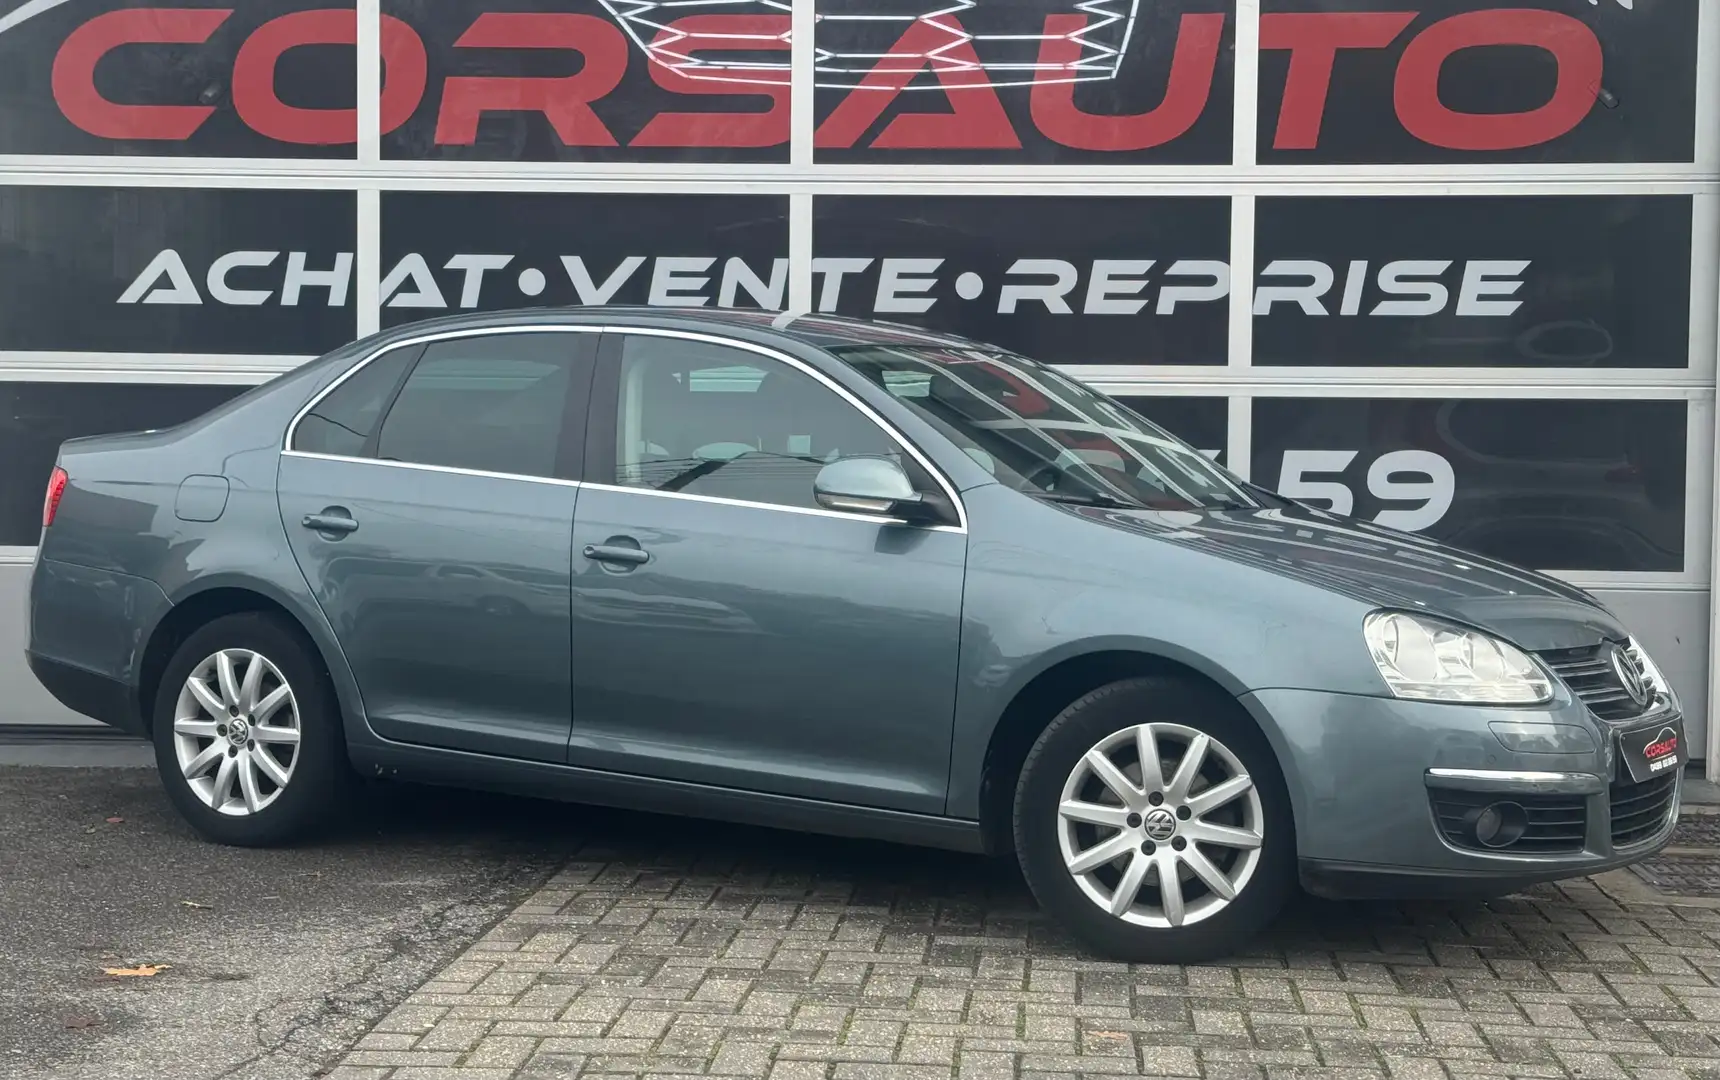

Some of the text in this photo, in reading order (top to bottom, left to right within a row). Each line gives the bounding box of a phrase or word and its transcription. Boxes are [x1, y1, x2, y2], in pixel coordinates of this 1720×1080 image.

[51, 8, 1603, 151] CORSAUTO
[116, 249, 1532, 316] ACHAT VENTE REPRISE
[1276, 449, 1456, 532] 59
